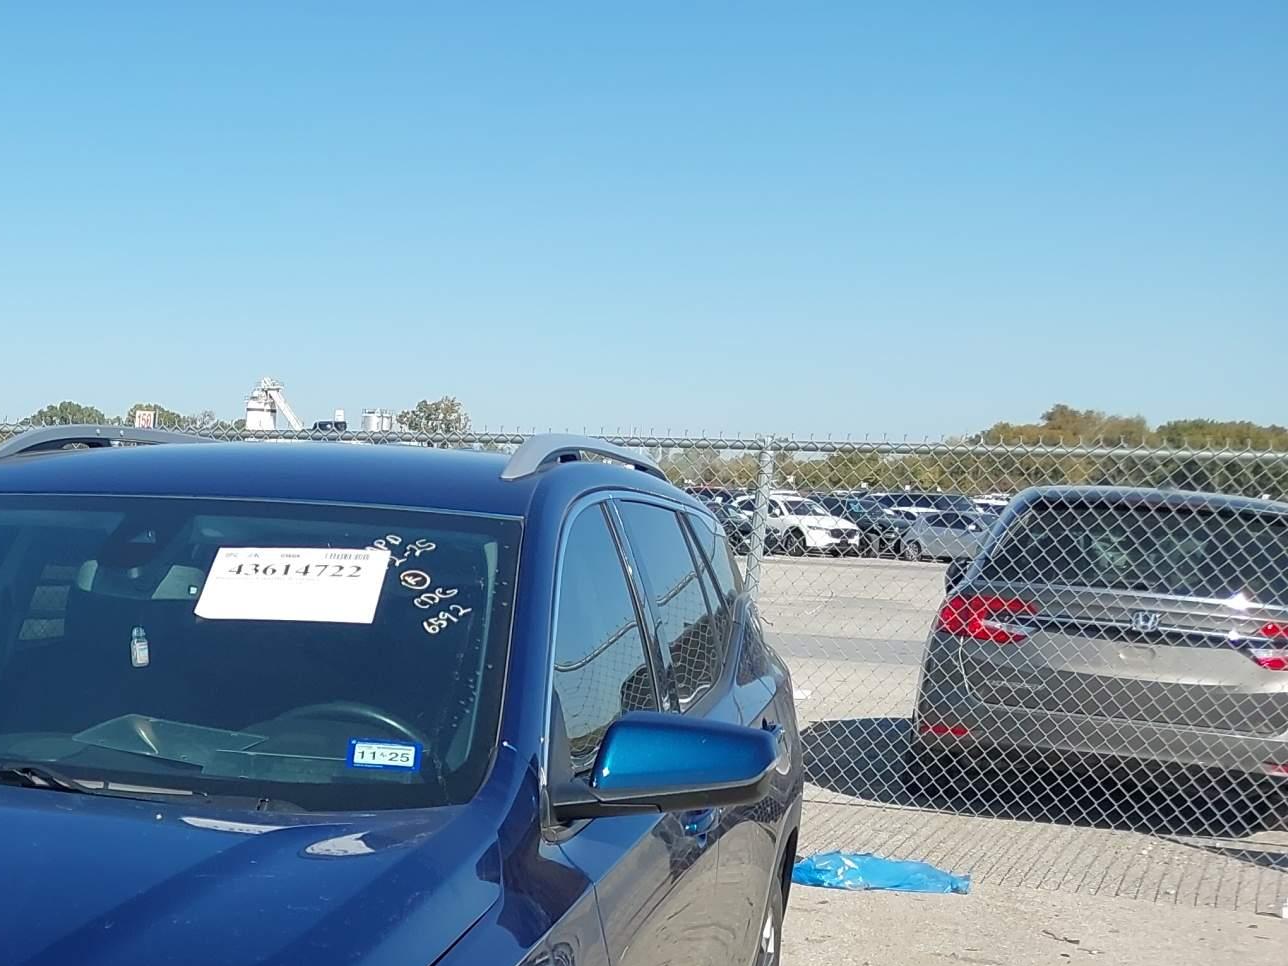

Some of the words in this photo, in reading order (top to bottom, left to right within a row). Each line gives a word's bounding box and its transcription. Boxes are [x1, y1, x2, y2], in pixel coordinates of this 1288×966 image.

[365, 534, 402, 551] PD
[228, 563, 363, 578] 43614722
[423, 604, 472, 634] 6592
